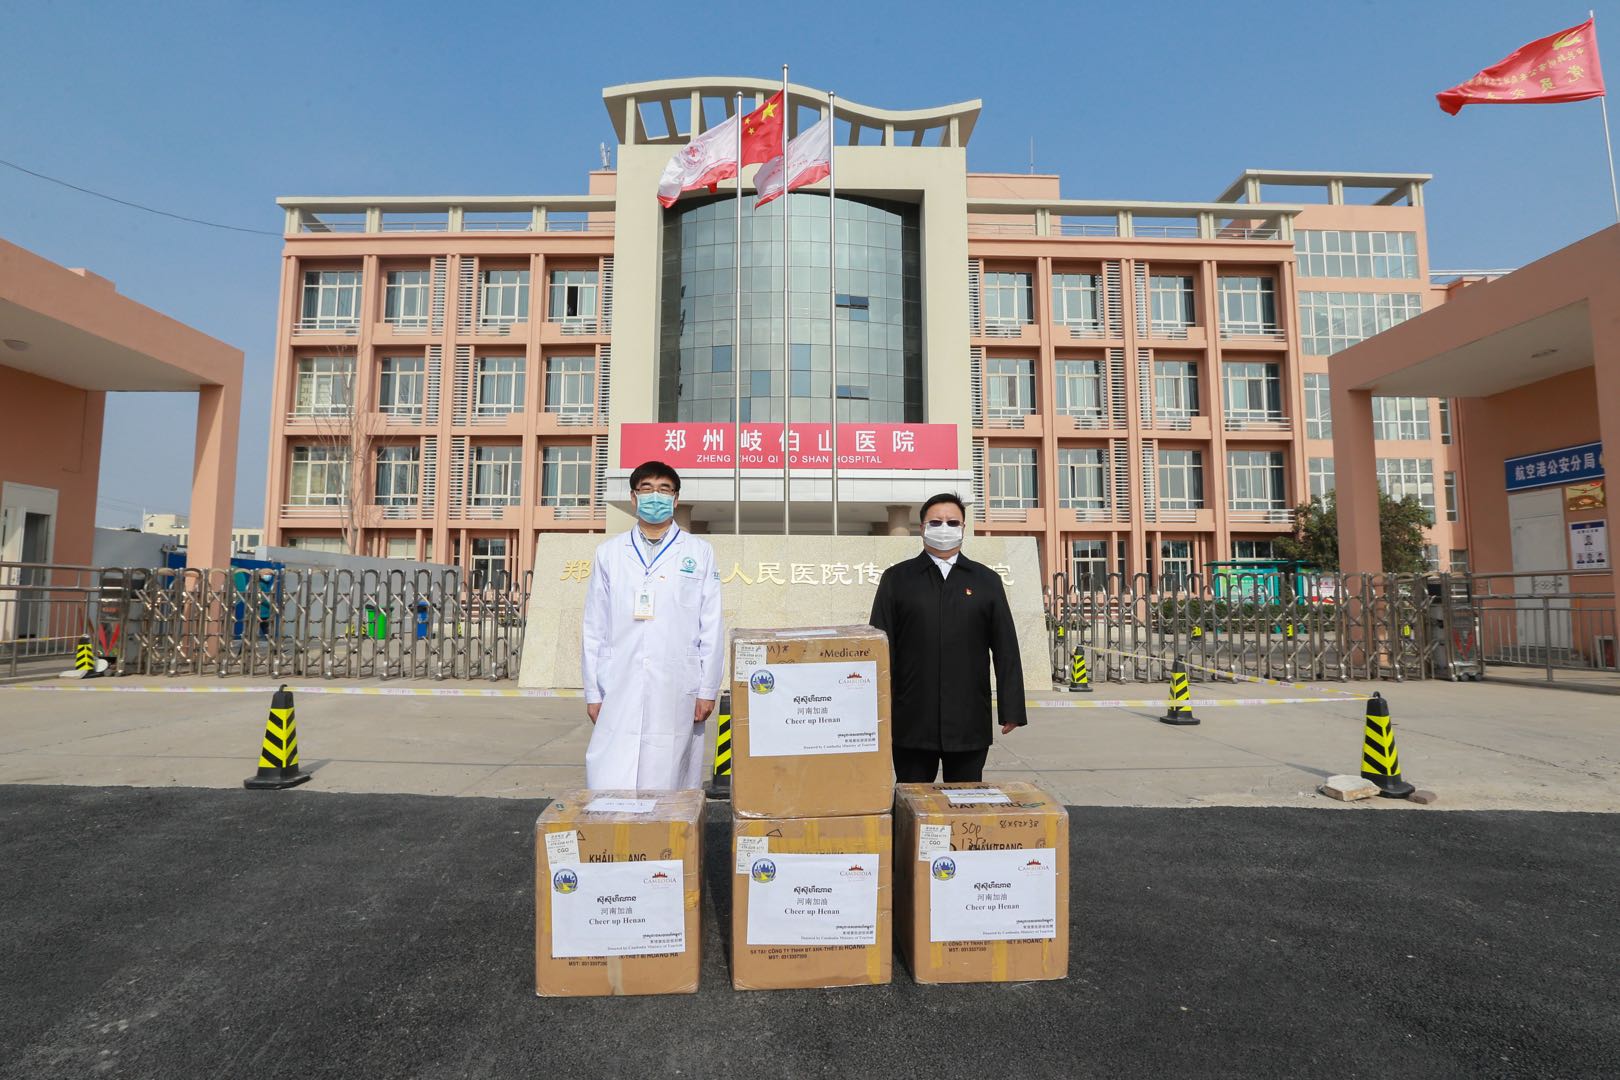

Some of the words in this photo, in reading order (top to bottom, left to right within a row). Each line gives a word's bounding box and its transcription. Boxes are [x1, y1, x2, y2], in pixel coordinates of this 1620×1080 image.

[696, 454, 731, 463] ZHENG
[767, 455, 779, 463] QI
[789, 455, 798, 463] O
[801, 455, 829, 463] SHAN
[1515, 452, 1596, 481] 航空港公安分局
[824, 648, 869, 658] Medicare
[797, 706, 829, 715] 河南加油
[818, 716, 841, 724] Henan
[796, 897, 828, 906] 河南加油
[977, 893, 1008, 901] 河南加油
[600, 906, 633, 915] 河南加油
[784, 907, 805, 915] Cheer
[611, 918, 621, 926] up
